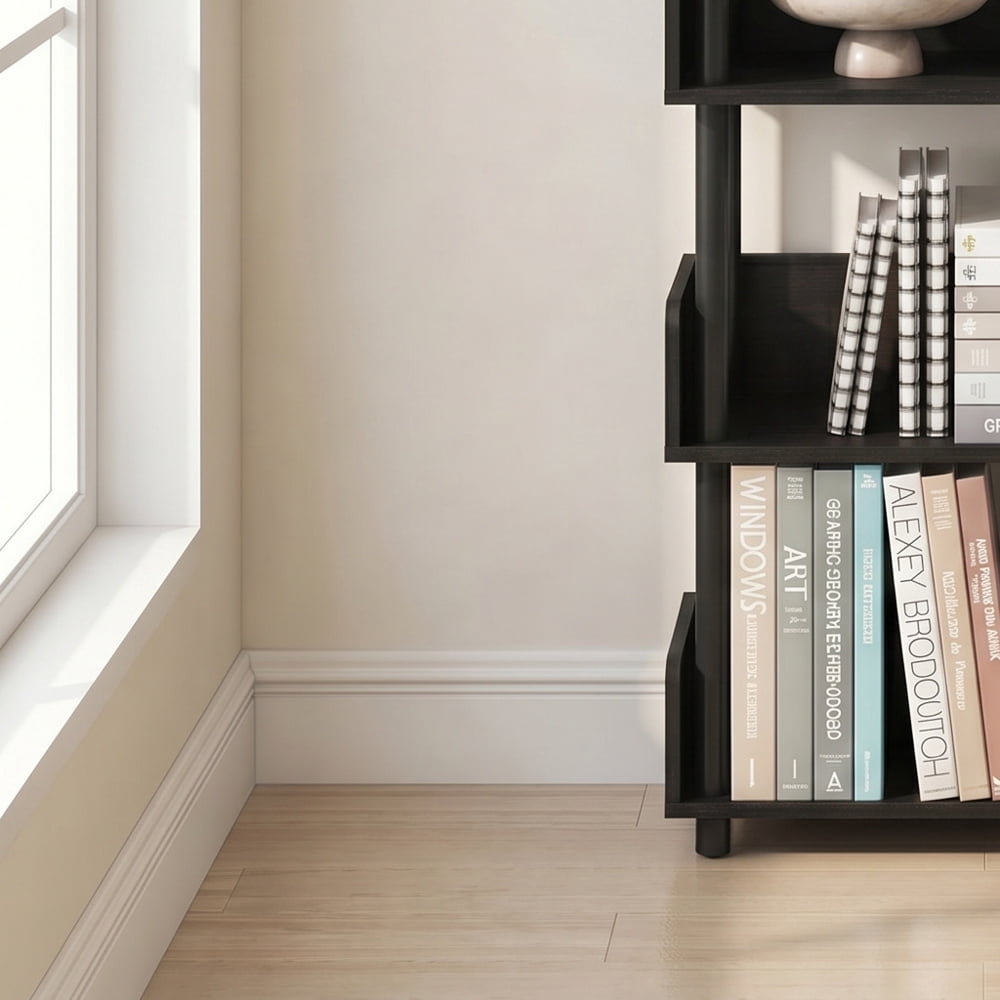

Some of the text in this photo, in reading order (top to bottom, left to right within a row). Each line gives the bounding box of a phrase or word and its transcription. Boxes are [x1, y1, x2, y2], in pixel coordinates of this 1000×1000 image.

[739, 475, 767, 616] WINDOWS
[783, 545, 808, 602] ART
[889, 484, 928, 588] ALEXEY
